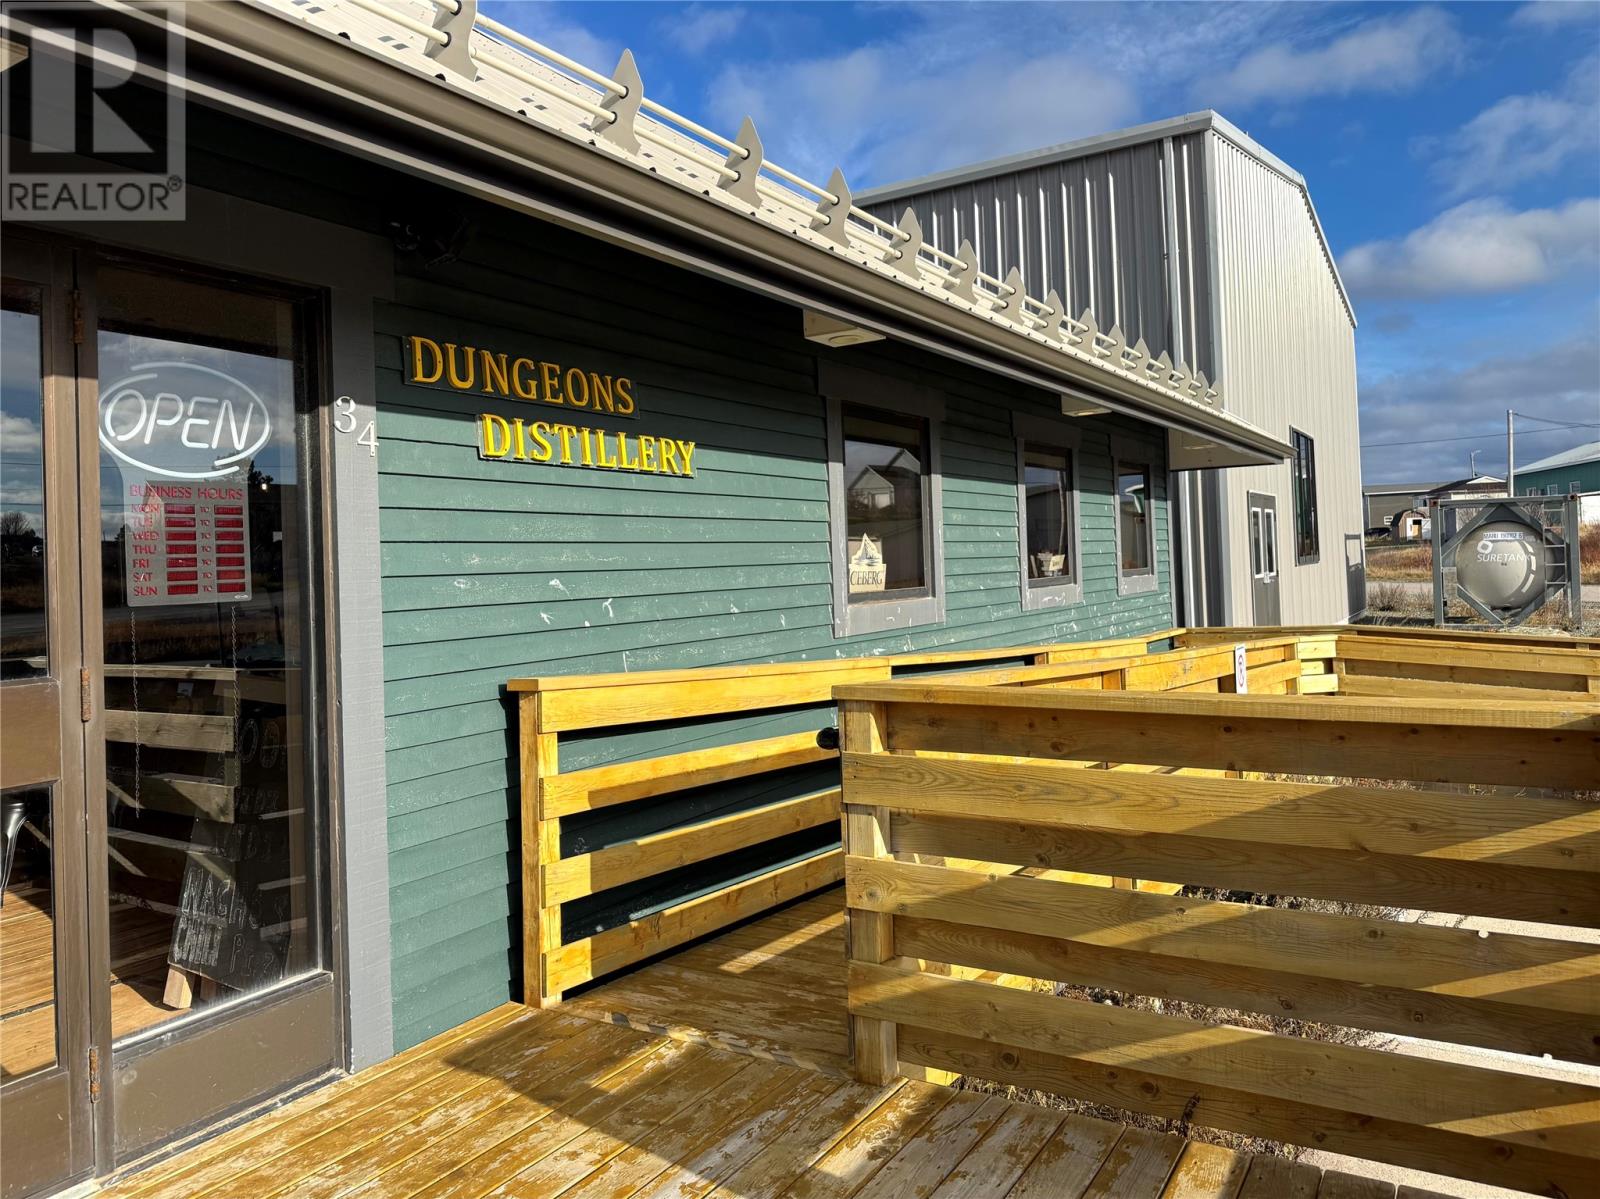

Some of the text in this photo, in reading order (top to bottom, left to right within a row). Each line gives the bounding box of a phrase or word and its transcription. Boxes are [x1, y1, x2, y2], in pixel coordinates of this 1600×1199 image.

[409, 336, 635, 414] DUNGEONS
[104, 388, 254, 450] OPEN
[333, 396, 379, 457] 34
[479, 413, 696, 476] DISTILLERY
[130, 484, 244, 500] BUSINESS HOURS
[132, 531, 160, 541] WED
[133, 544, 157, 554] THU
[133, 558, 149, 568] FRI
[133, 571, 153, 582] SAT
[134, 586, 158, 596] SUN
